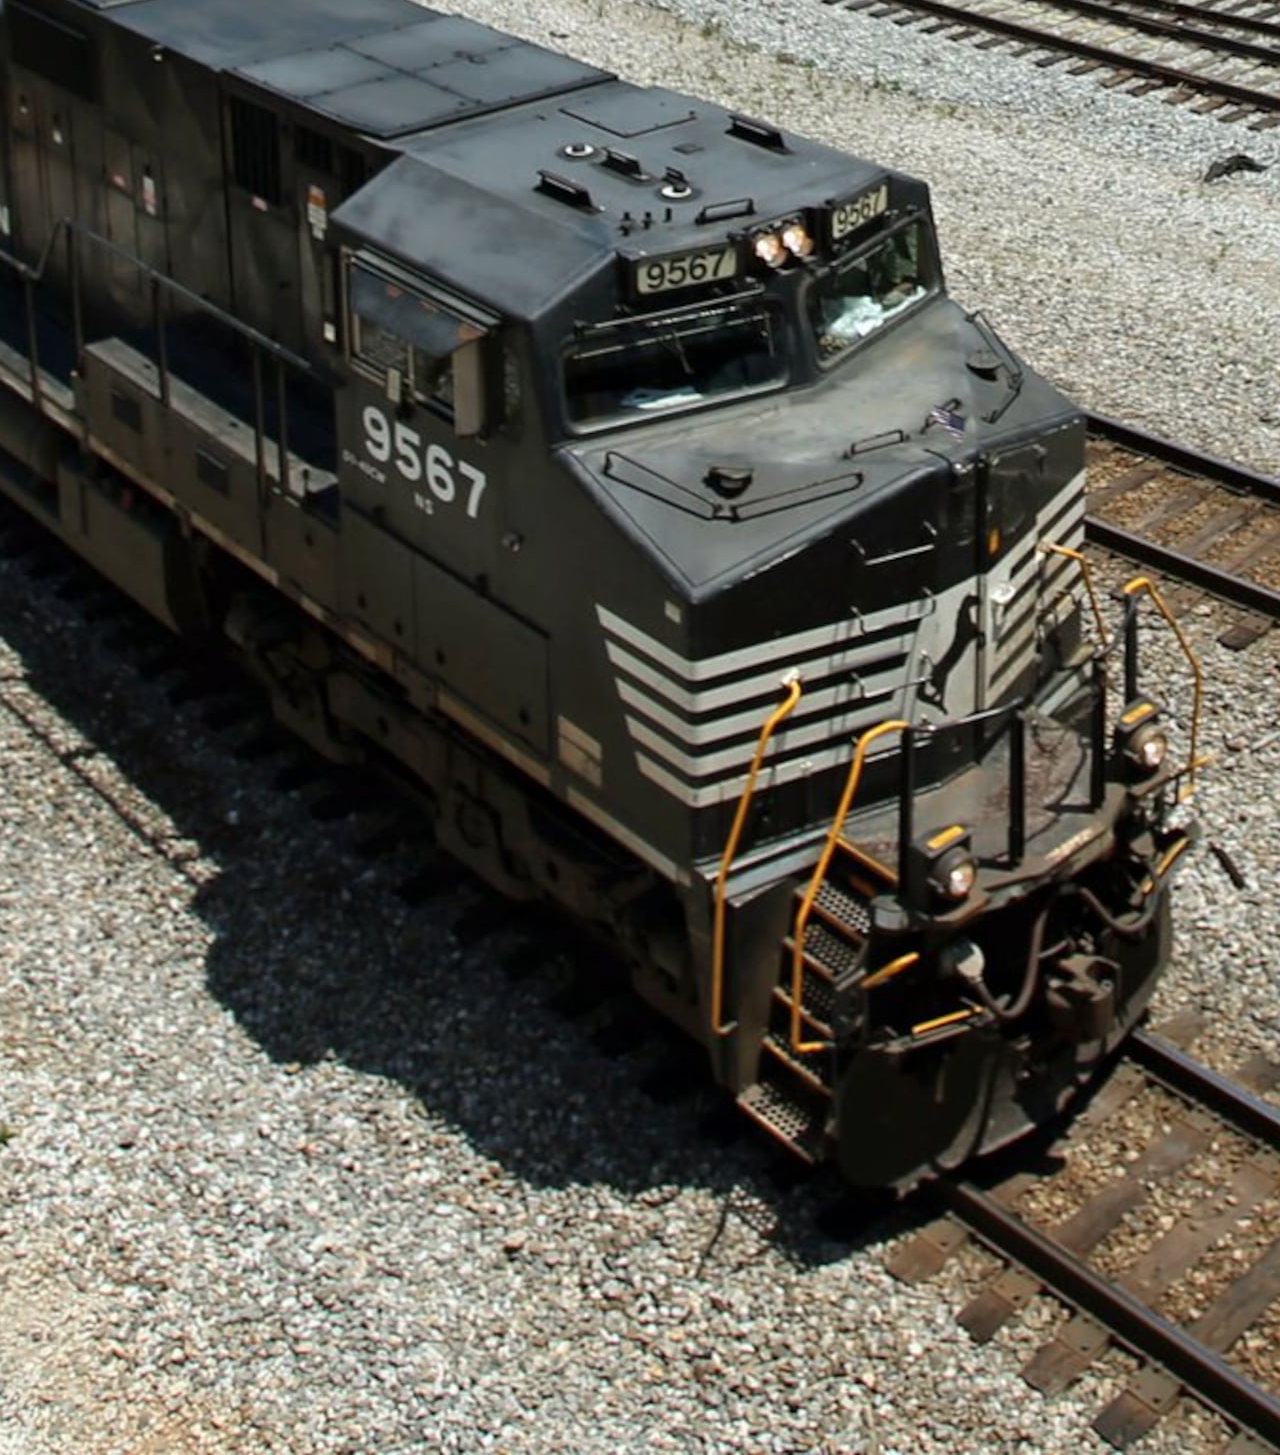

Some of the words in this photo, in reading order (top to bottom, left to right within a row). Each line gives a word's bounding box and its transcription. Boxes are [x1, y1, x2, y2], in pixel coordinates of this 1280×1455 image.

[836, 185, 884, 235] 9567
[646, 251, 727, 290] 9567
[362, 405, 487, 519] 9567
